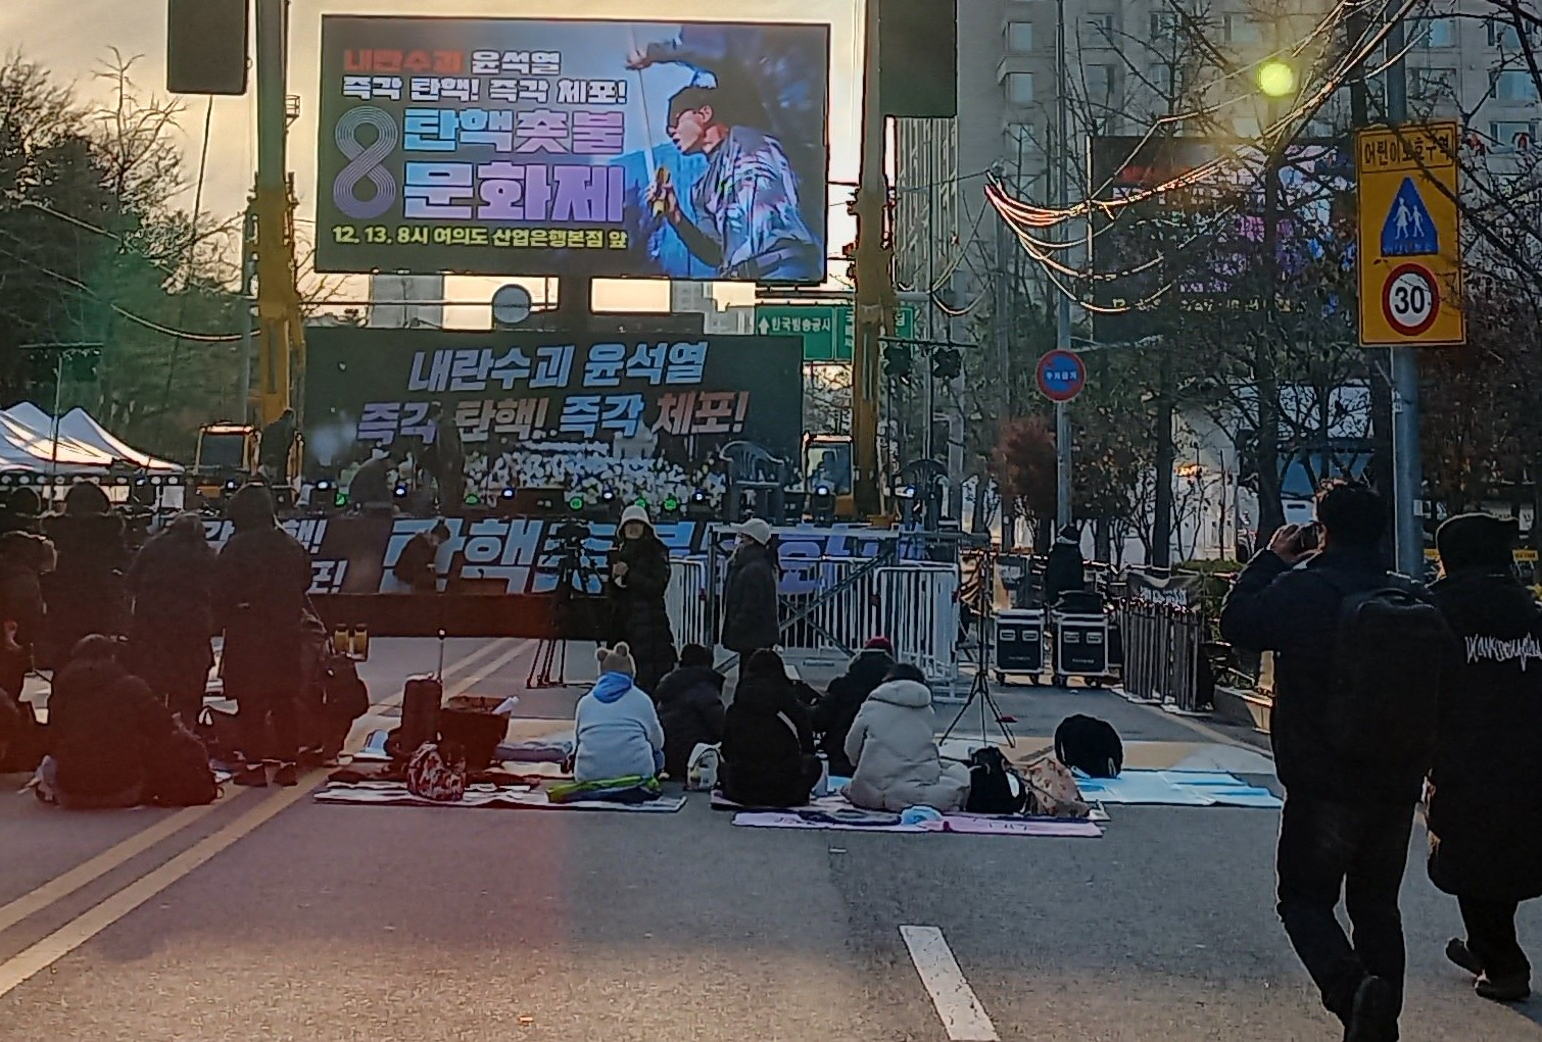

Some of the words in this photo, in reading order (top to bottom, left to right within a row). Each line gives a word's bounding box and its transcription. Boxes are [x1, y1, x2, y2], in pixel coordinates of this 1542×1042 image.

[471, 50, 561, 75] 윤석열
[343, 76, 402, 100] 즉각
[410, 77, 479, 101] 탄핵!
[489, 78, 549, 102] 즉각
[557, 79, 627, 104] 체포!
[403, 108, 625, 154] 탄핵촛불
[403, 161, 625, 222] 문화제
[397, 228, 428, 245] 8시
[433, 227, 488, 245] 여의도
[1394, 286, 1426, 314] 30
[408, 345, 575, 392] 내란수괴
[582, 341, 708, 387] 윤석열
[455, 397, 548, 443] 탄핵!
[559, 393, 645, 438] 즉각
[657, 390, 751, 435] 체포!
